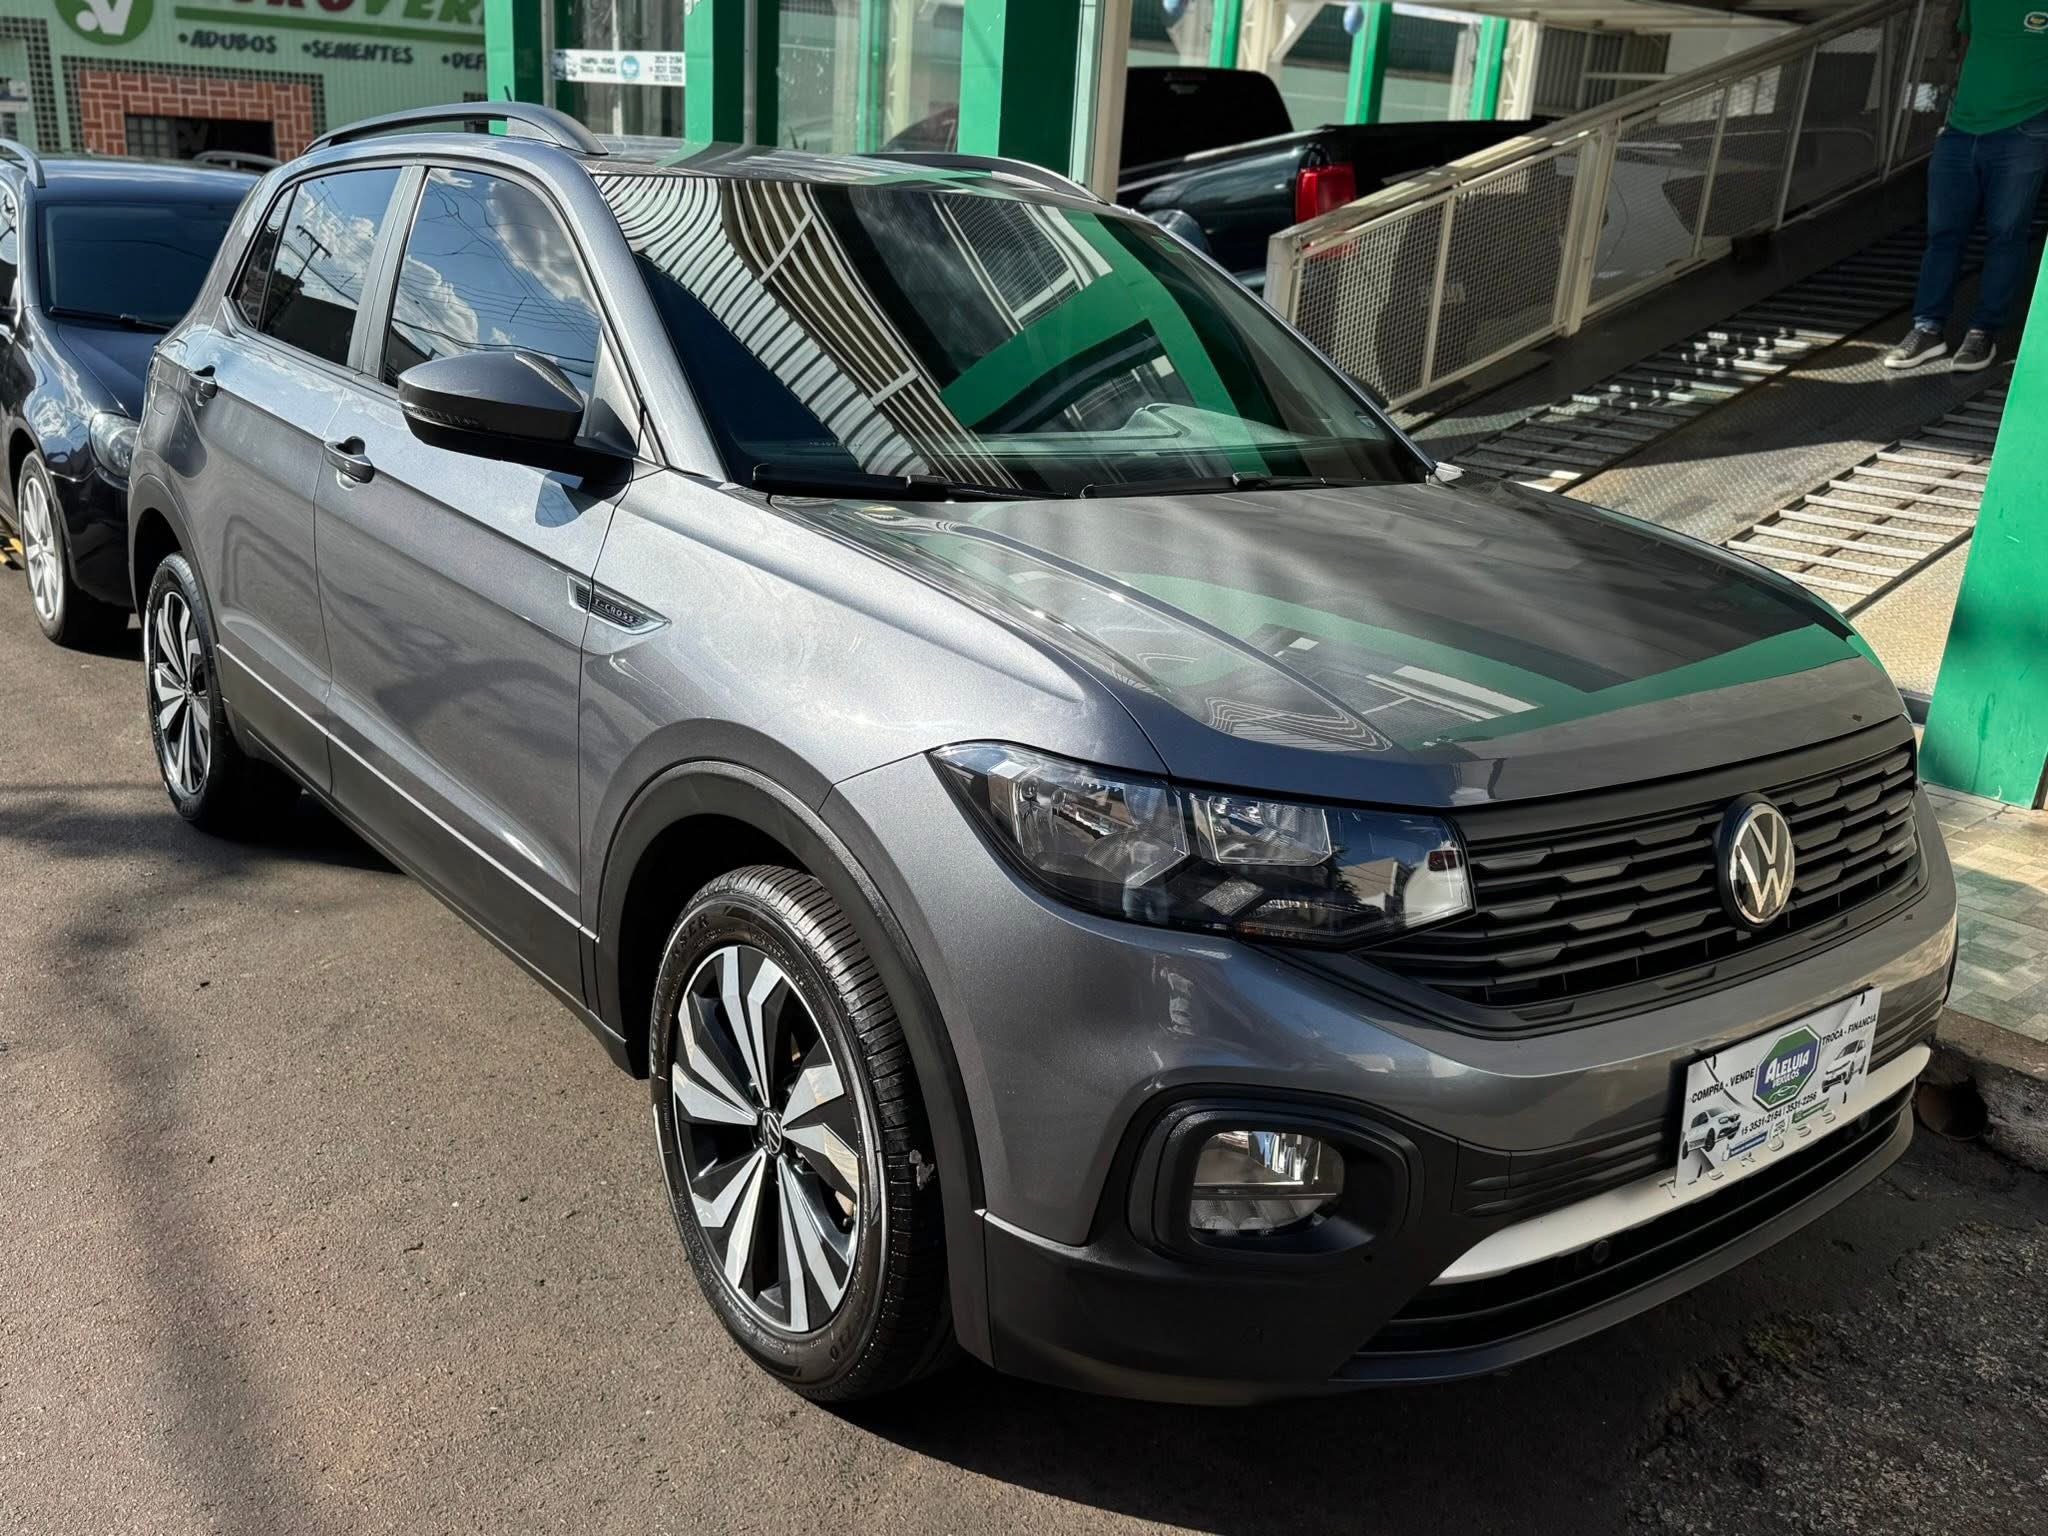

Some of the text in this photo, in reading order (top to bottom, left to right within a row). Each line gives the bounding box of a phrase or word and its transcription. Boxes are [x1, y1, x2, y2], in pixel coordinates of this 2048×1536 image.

[190, 29, 277, 54] ADUBOS
[312, 40, 414, 65] SEMENTES
[594, 598, 635, 622] T-CROSS
[1822, 1028, 1843, 1046] TROCA
[1847, 1013, 1876, 1034] FINANCIA
[1764, 1049, 1810, 1085] ALELUIA
[1691, 1081, 1724, 1104] COMPRA
[1730, 1067, 1755, 1087] VENDE
